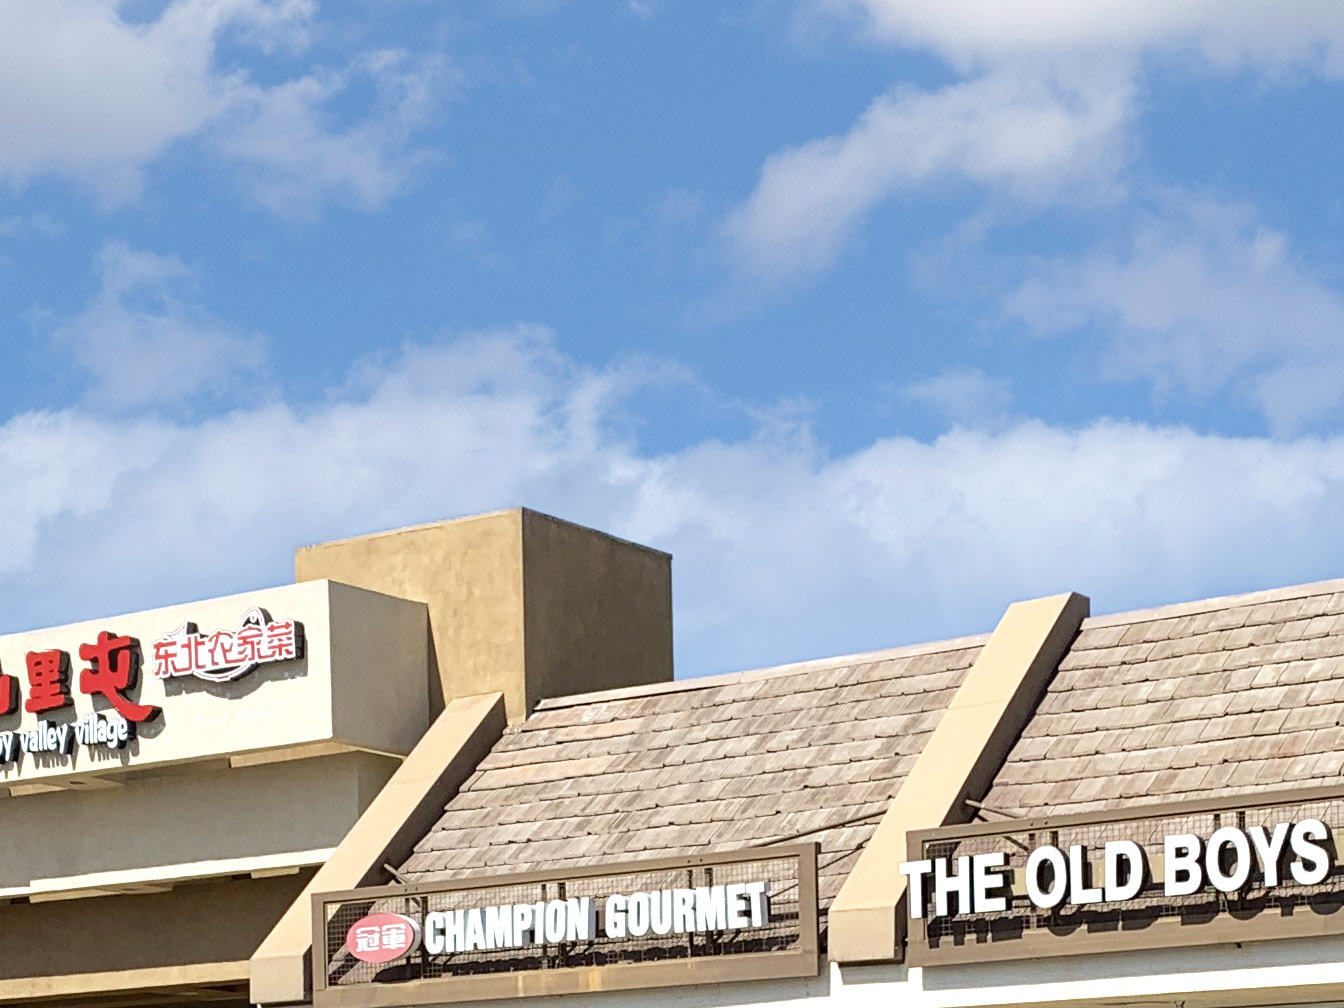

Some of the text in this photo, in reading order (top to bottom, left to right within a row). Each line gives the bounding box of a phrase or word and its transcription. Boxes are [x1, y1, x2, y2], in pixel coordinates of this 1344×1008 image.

[153, 620, 294, 677] 东北农家菜
[20, 719, 70, 755] valley
[74, 712, 129, 749] village
[898, 818, 1330, 919] THE OLD BOYS
[355, 922, 407, 951] 冠軍
[425, 881, 768, 955] CHAMPION GOURMET
